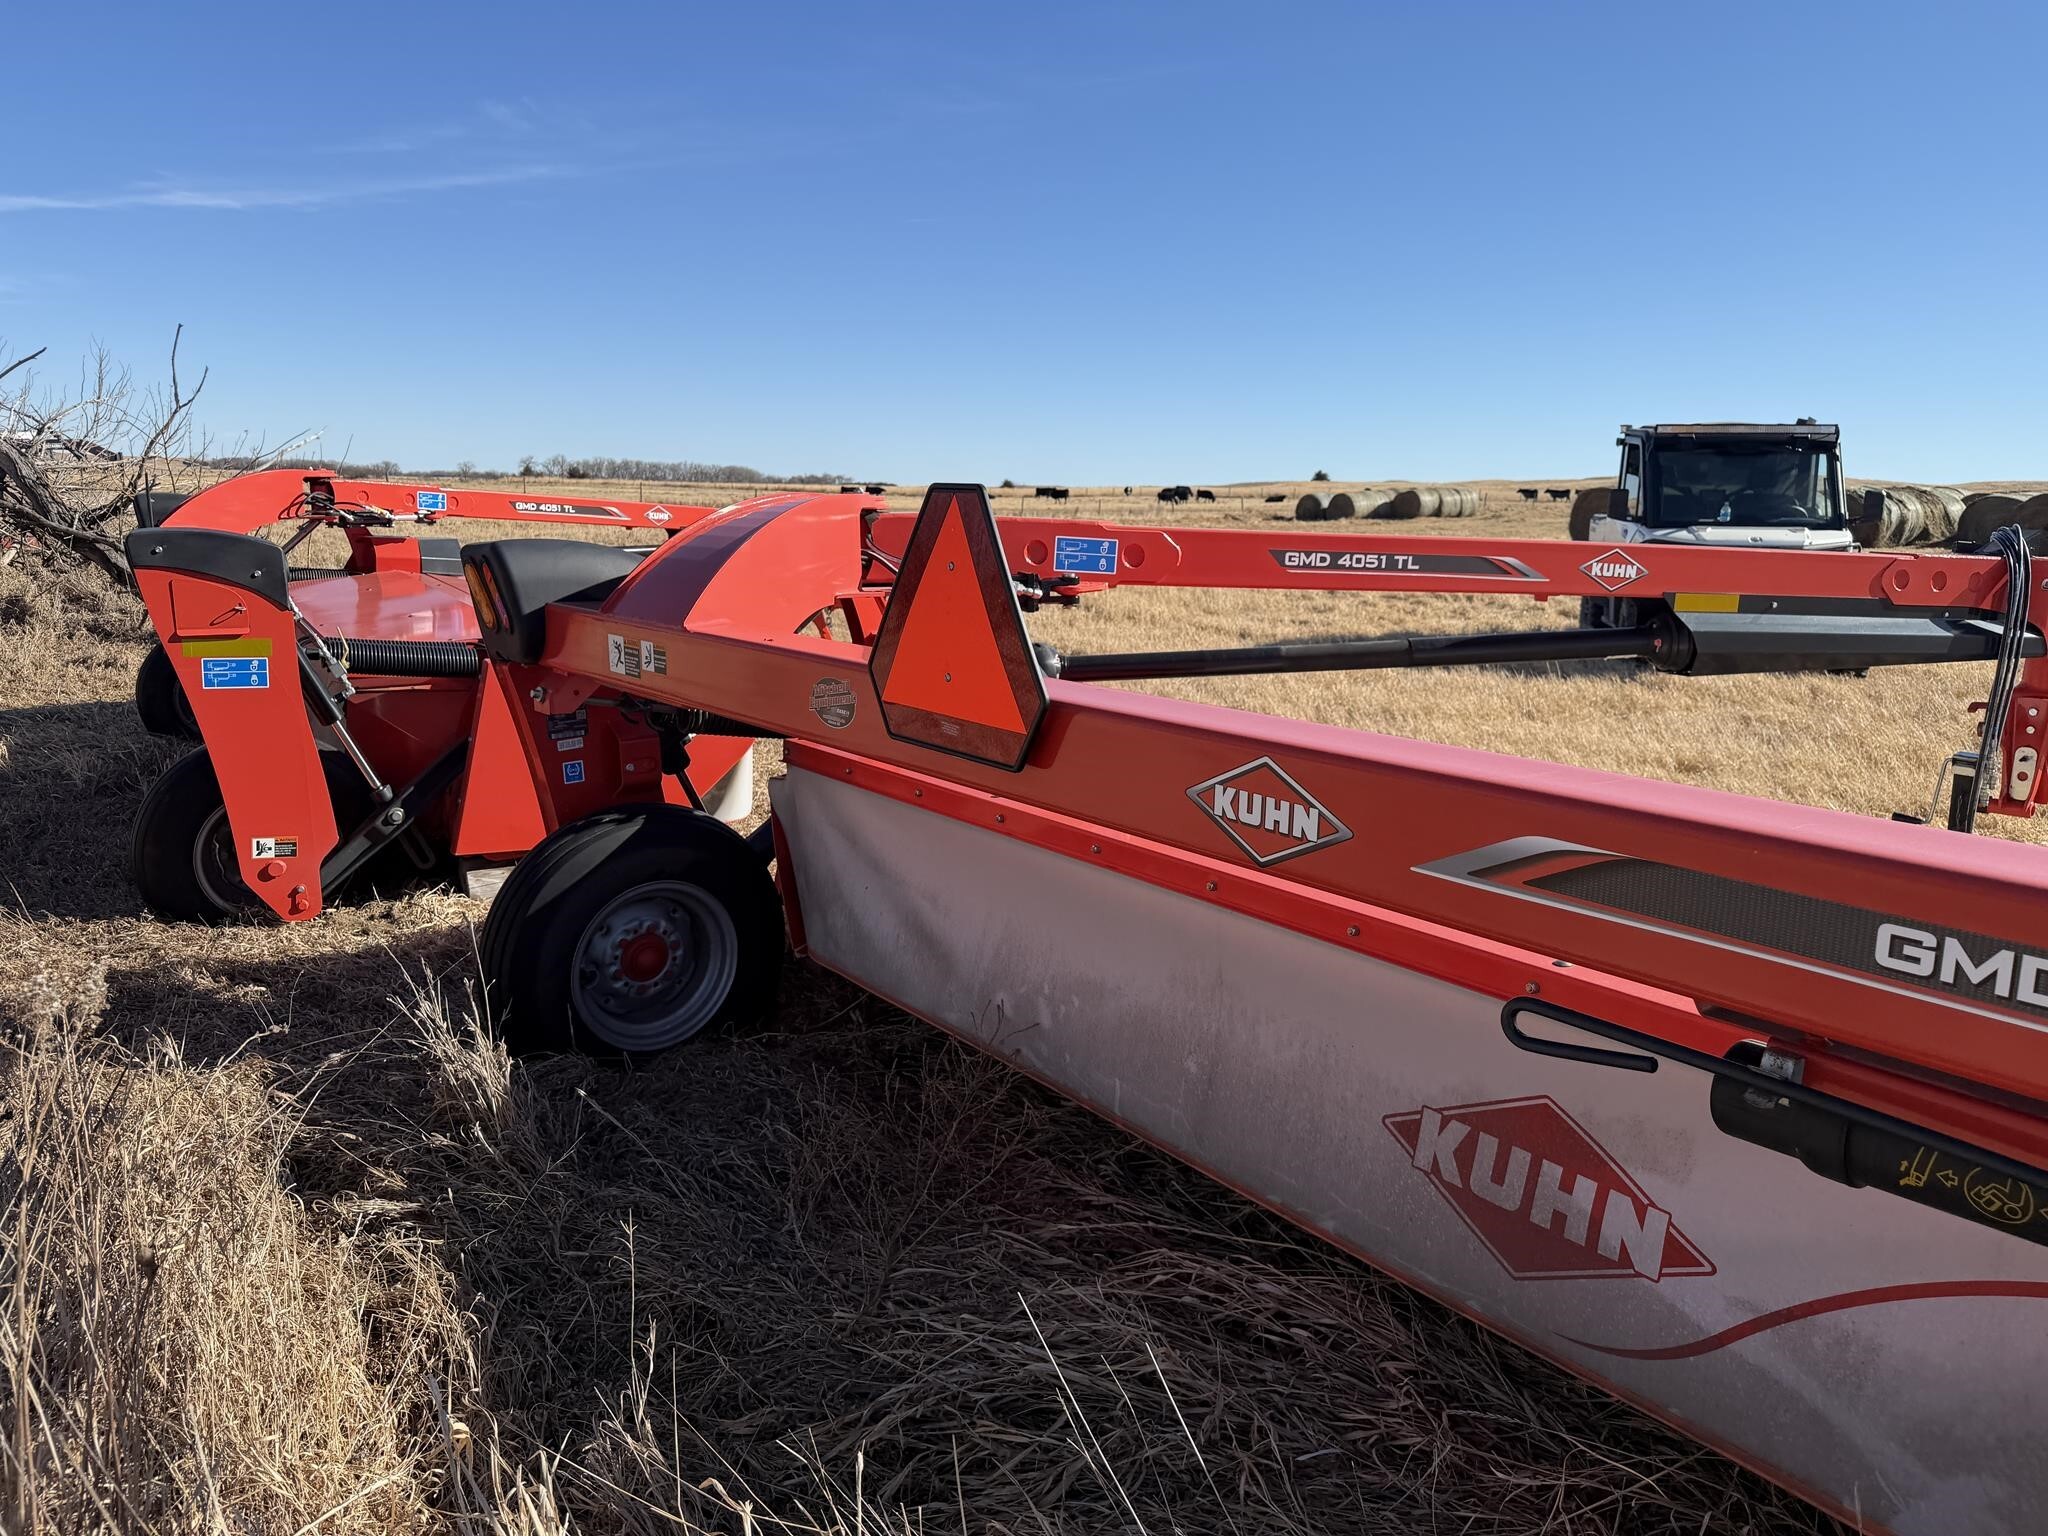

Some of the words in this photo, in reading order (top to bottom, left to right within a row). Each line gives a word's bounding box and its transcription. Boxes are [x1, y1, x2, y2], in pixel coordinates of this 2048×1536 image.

[515, 502, 537, 511] GMD
[539, 504, 562, 512] 4051
[564, 505, 576, 513] TL
[649, 512, 669, 520] KUHN
[1285, 552, 1330, 567] GMD
[1337, 553, 1386, 568] 4051
[1394, 555, 1420, 570] TL
[1591, 562, 1637, 579] KUHN
[1213, 783, 1319, 843] KUHN
[1412, 1105, 1672, 1283] KUHN
